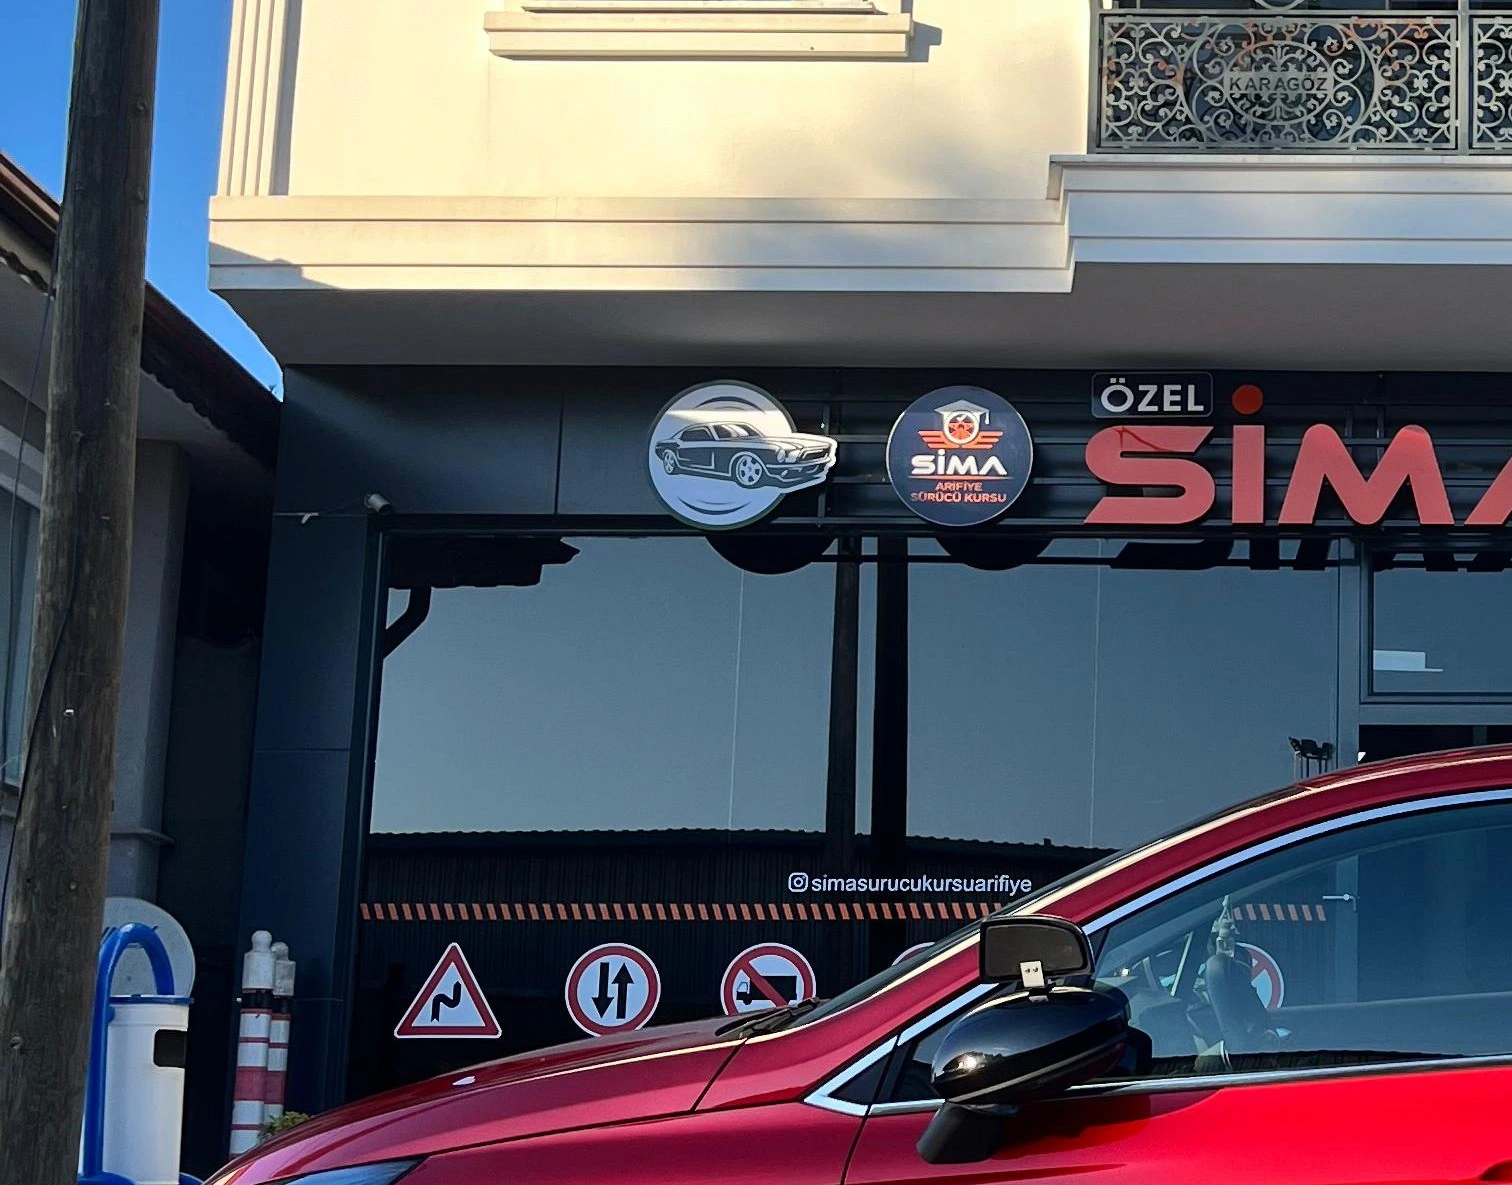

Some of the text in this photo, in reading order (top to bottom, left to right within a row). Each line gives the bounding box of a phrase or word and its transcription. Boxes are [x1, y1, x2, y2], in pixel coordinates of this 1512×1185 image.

[1229, 73, 1328, 92] KARAGÖZ
[1100, 378, 1204, 413] ÖZEL
[911, 449, 1008, 476] SİMA
[935, 481, 983, 492] ARİFİYE
[910, 491, 1007, 503] SÜRÜCÜ KURSU
[811, 874, 1032, 896] simasurucukursuarifiye
